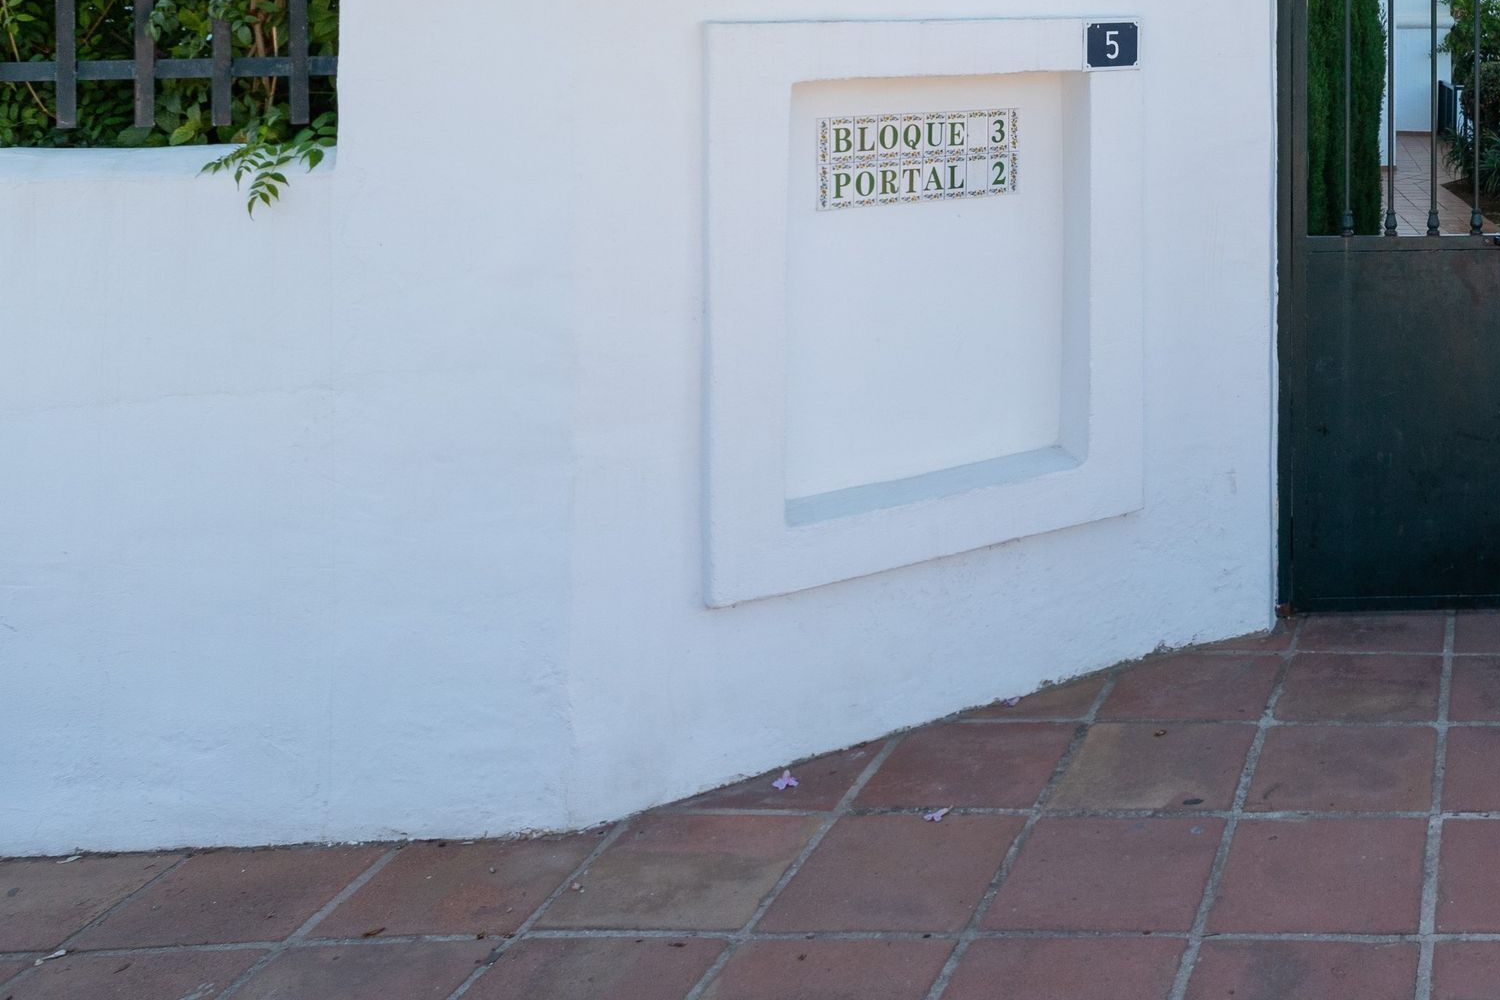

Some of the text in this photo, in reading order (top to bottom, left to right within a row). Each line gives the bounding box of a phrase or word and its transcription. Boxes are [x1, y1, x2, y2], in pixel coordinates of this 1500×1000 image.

[1105, 30, 1120, 60] 5
[833, 119, 1005, 154] BLOQUE 3
[832, 161, 1006, 199] PORTAL 2
